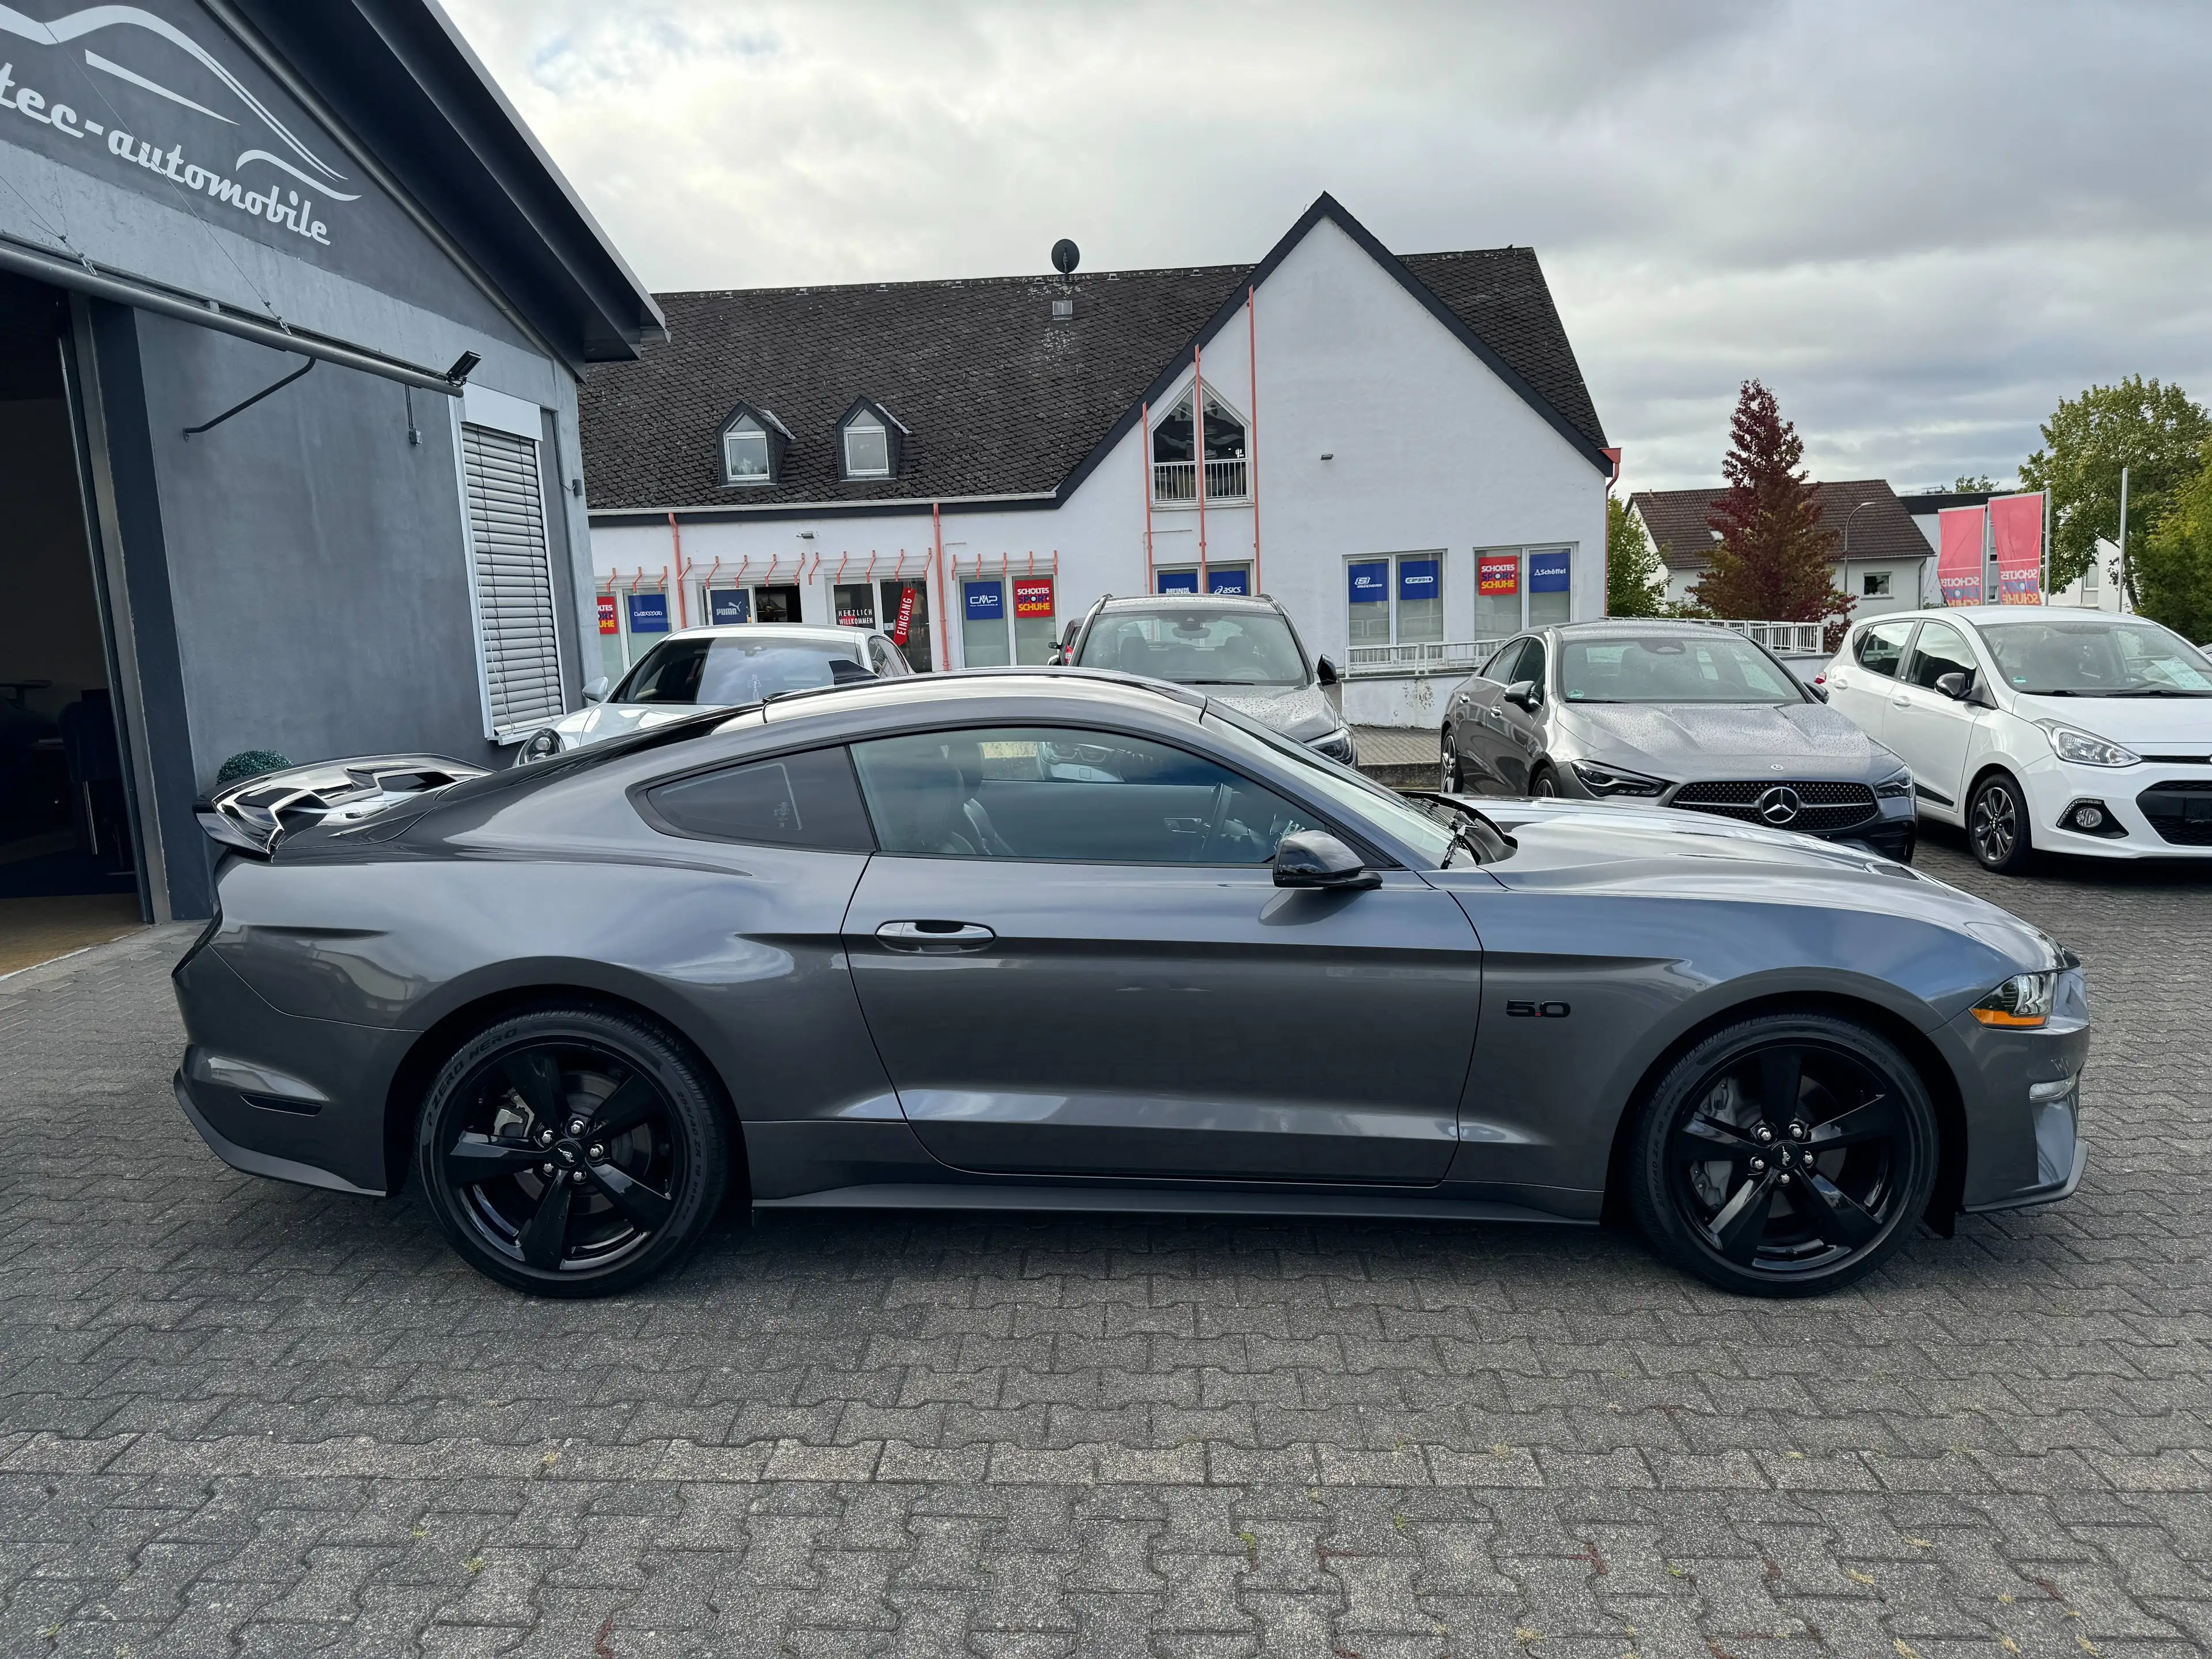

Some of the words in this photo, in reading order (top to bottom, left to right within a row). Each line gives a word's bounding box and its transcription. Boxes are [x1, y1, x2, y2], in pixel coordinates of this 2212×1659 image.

[1481, 564, 1516, 573] SCHOLTES
[1481, 579, 1516, 589] SCHUHE
[969, 594, 998, 604] CMP
[716, 608, 737, 616] PUMA
[1018, 602, 1050, 612] SCHUHE
[897, 597, 912, 635] EINGANG
[839, 618, 873, 626] WILLKOMMEN
[1506, 999, 1571, 1018] 5.0
[431, 1060, 464, 1111] ZERO
[469, 1028, 518, 1062] NERO
[694, 1138, 702, 1159] ZR
[695, 1164, 702, 1177] 19
